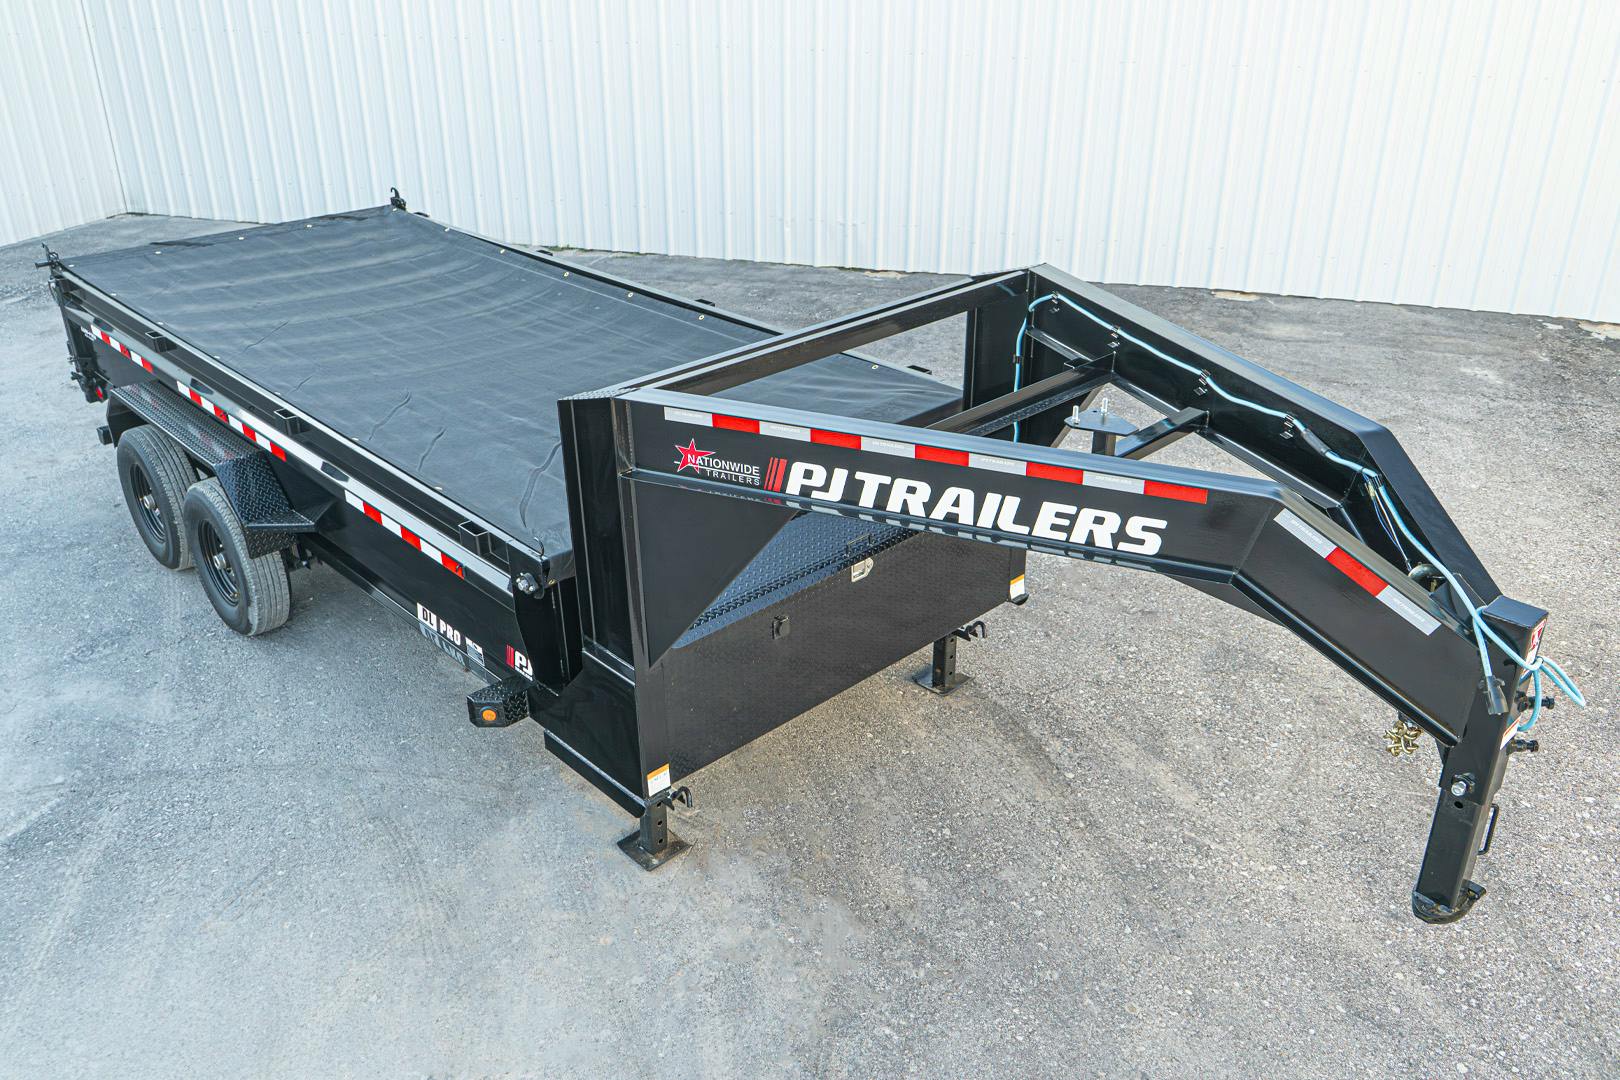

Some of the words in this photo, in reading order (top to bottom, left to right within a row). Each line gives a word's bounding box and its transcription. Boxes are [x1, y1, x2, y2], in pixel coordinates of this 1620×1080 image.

[687, 453, 760, 476] NATIONWIDE
[705, 469, 760, 486] TRAILERS
[785, 461, 849, 502] PJ
[854, 471, 1168, 556] TRAILERS
[440, 619, 461, 646] PRO
